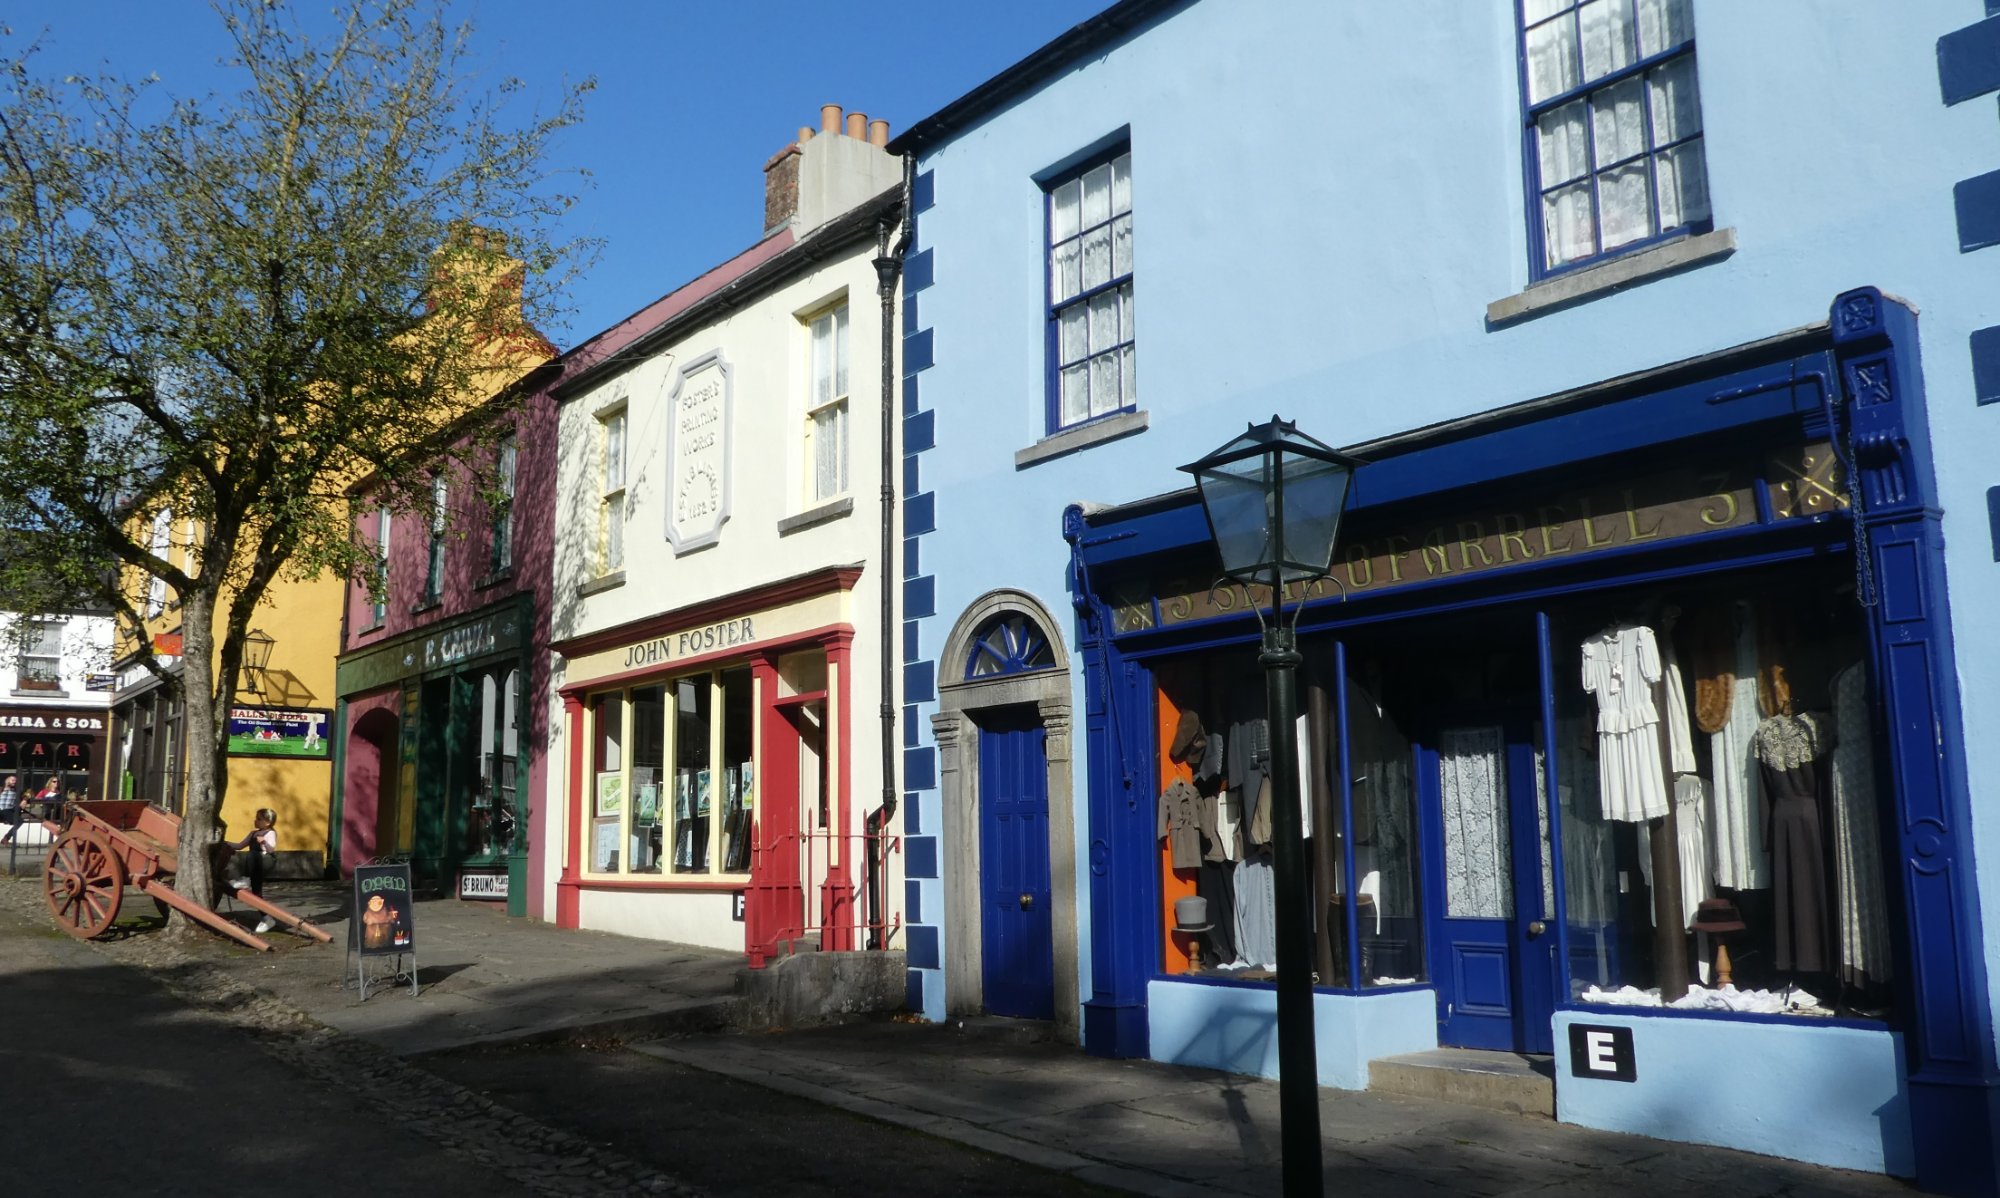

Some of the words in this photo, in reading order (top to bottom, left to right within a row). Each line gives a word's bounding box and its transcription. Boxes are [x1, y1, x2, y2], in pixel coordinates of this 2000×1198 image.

[683, 431, 716, 456] WORKS
[624, 637, 671, 668] JOHN
[679, 617, 755, 656] FOSTER
[52, 718, 62, 728] &
[471, 877, 494, 893] BRUNO
[1586, 1031, 1617, 1072] E
